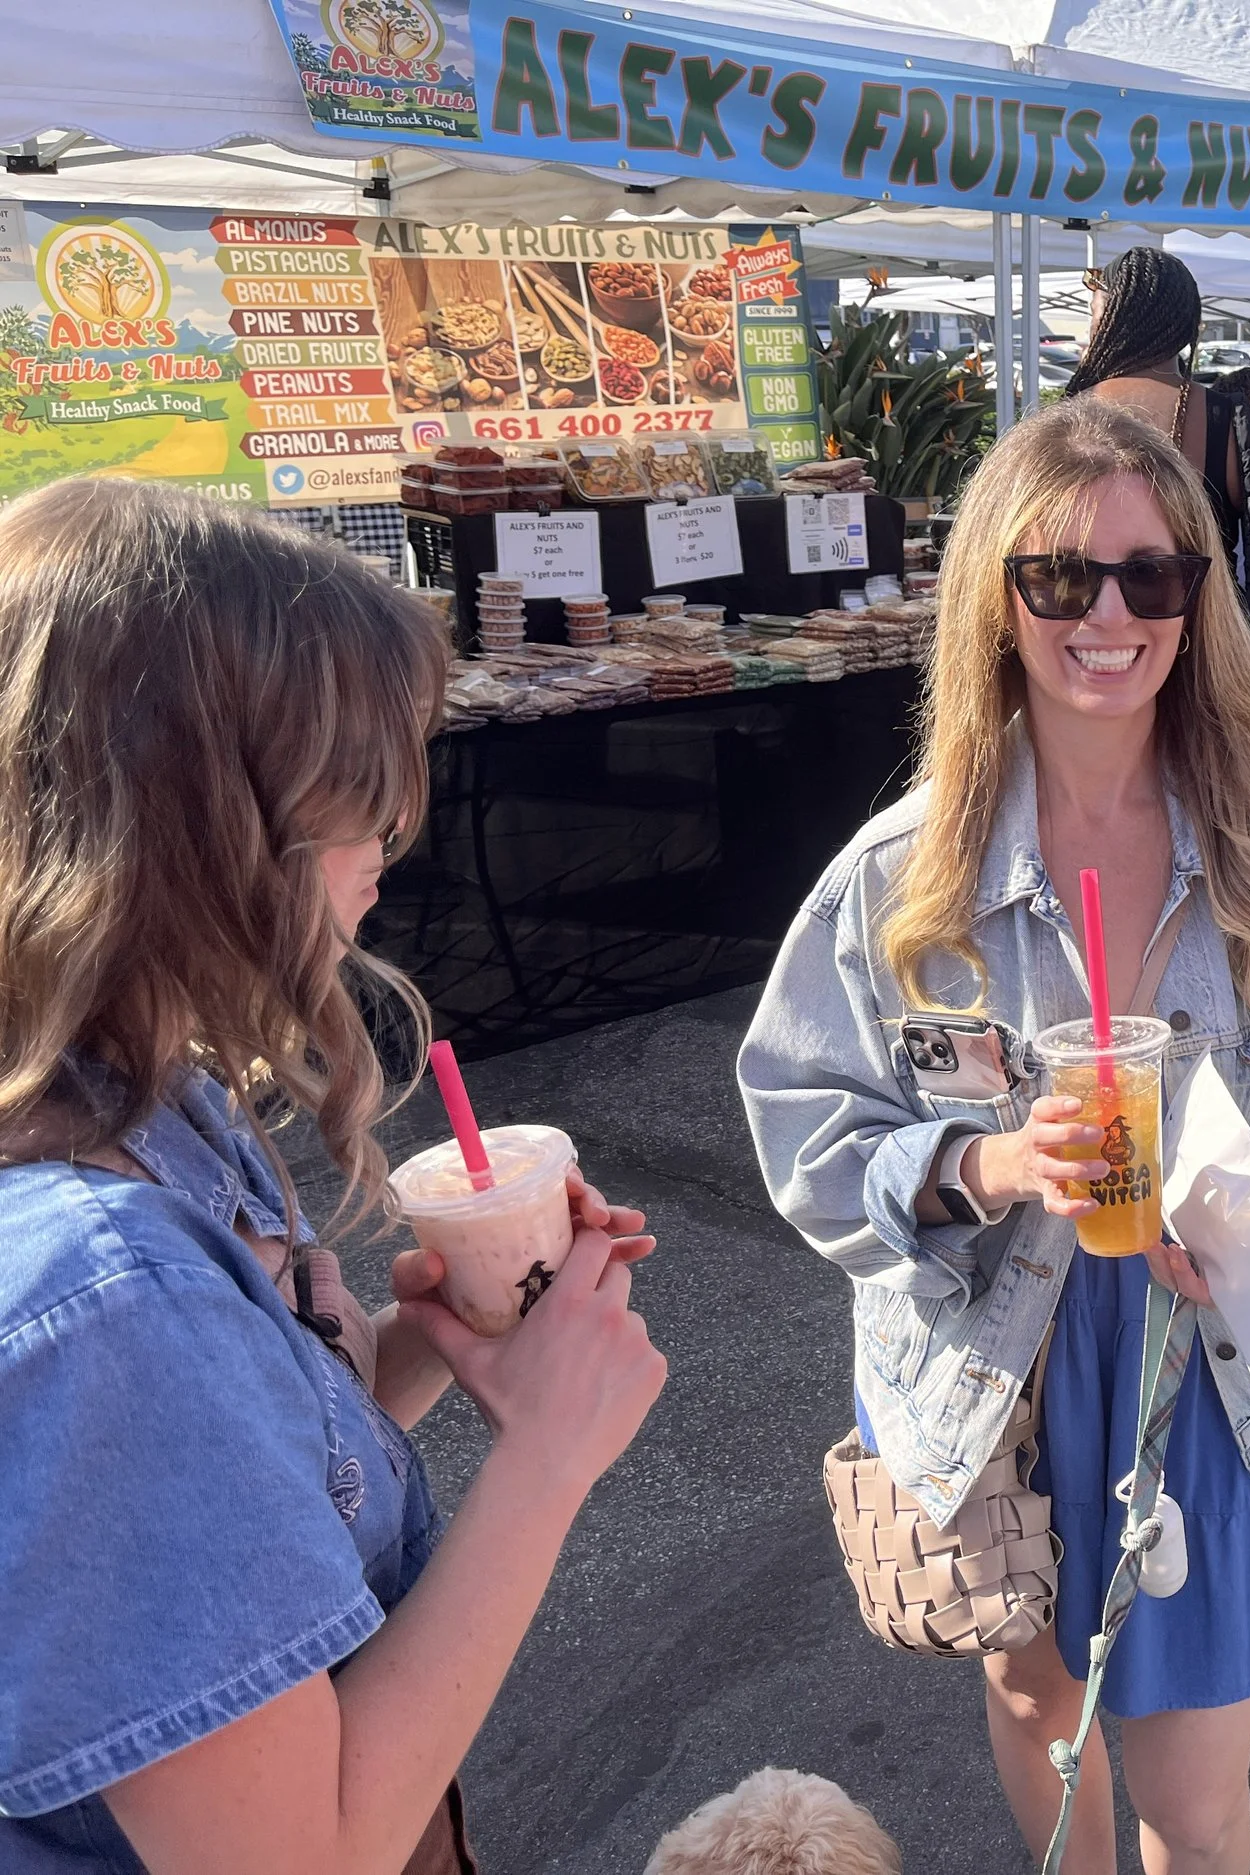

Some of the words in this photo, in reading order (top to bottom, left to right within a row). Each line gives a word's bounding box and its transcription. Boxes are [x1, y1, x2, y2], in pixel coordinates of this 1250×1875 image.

[330, 43, 442, 84] ALEX'S
[302, 71, 385, 101] Fruits
[391, 86, 408, 103] &
[414, 85, 475, 111] Nuts
[333, 107, 384, 128] Healthy
[385, 112, 422, 125] Snack
[424, 114, 457, 132] Food
[493, 16, 827, 170] ALEX'S
[841, 80, 1106, 205] FRUITS
[1123, 114, 1168, 207] &
[225, 218, 328, 242] ALMONDS
[374, 221, 490, 255] ALEX'S
[500, 226, 606, 258] FRUITS
[616, 234, 637, 258] &
[643, 230, 718, 260] NUTS
[230, 250, 351, 273] PISTACHOS
[736, 247, 790, 275] Always
[234, 281, 308, 304] BRAZIL
[311, 282, 364, 304] NUTS
[741, 276, 785, 300] Fresh
[242, 311, 294, 334] PINE
[301, 311, 360, 334] NUTS
[748, 306, 771, 316] SINCE
[774, 306, 794, 315] 1999
[49, 311, 177, 350] ALEX'S
[744, 327, 804, 346] GLUTEN
[243, 342, 302, 365] DRIED
[308, 341, 378, 365] FRUITS
[755, 345, 794, 363] FREE
[11, 355, 113, 385] Fruits
[120, 359, 142, 382] &
[147, 352, 223, 381] Nuts
[253, 372, 354, 396] PEANUTS
[762, 377, 797, 395] NON
[50, 400, 110, 422] Healthy
[112, 394, 159, 416] Snack
[161, 393, 203, 414] Food
[260, 402, 327, 426] TRAIL
[333, 401, 373, 423] MIX
[763, 394, 799, 413] GMO
[474, 416, 544, 441] 661
[558, 413, 622, 437] 400
[633, 409, 714, 432] 2377
[249, 431, 350, 456] GRANOLA
[354, 439, 362, 451] &
[364, 434, 400, 451] MORE
[770, 439, 817, 458] EGAN
[705, 505, 722, 513] AND
[510, 522, 536, 531] ALEX'S
[537, 522, 564, 530] FRUITS
[566, 521, 585, 530] AND
[537, 534, 558, 542] NUTS
[688, 531, 704, 539] each
[533, 545, 543, 555] $7
[544, 546, 564, 554] each
[538, 570, 550, 580] get
[568, 569, 585, 577] free
[1089, 1179, 1151, 1206] WITCH
